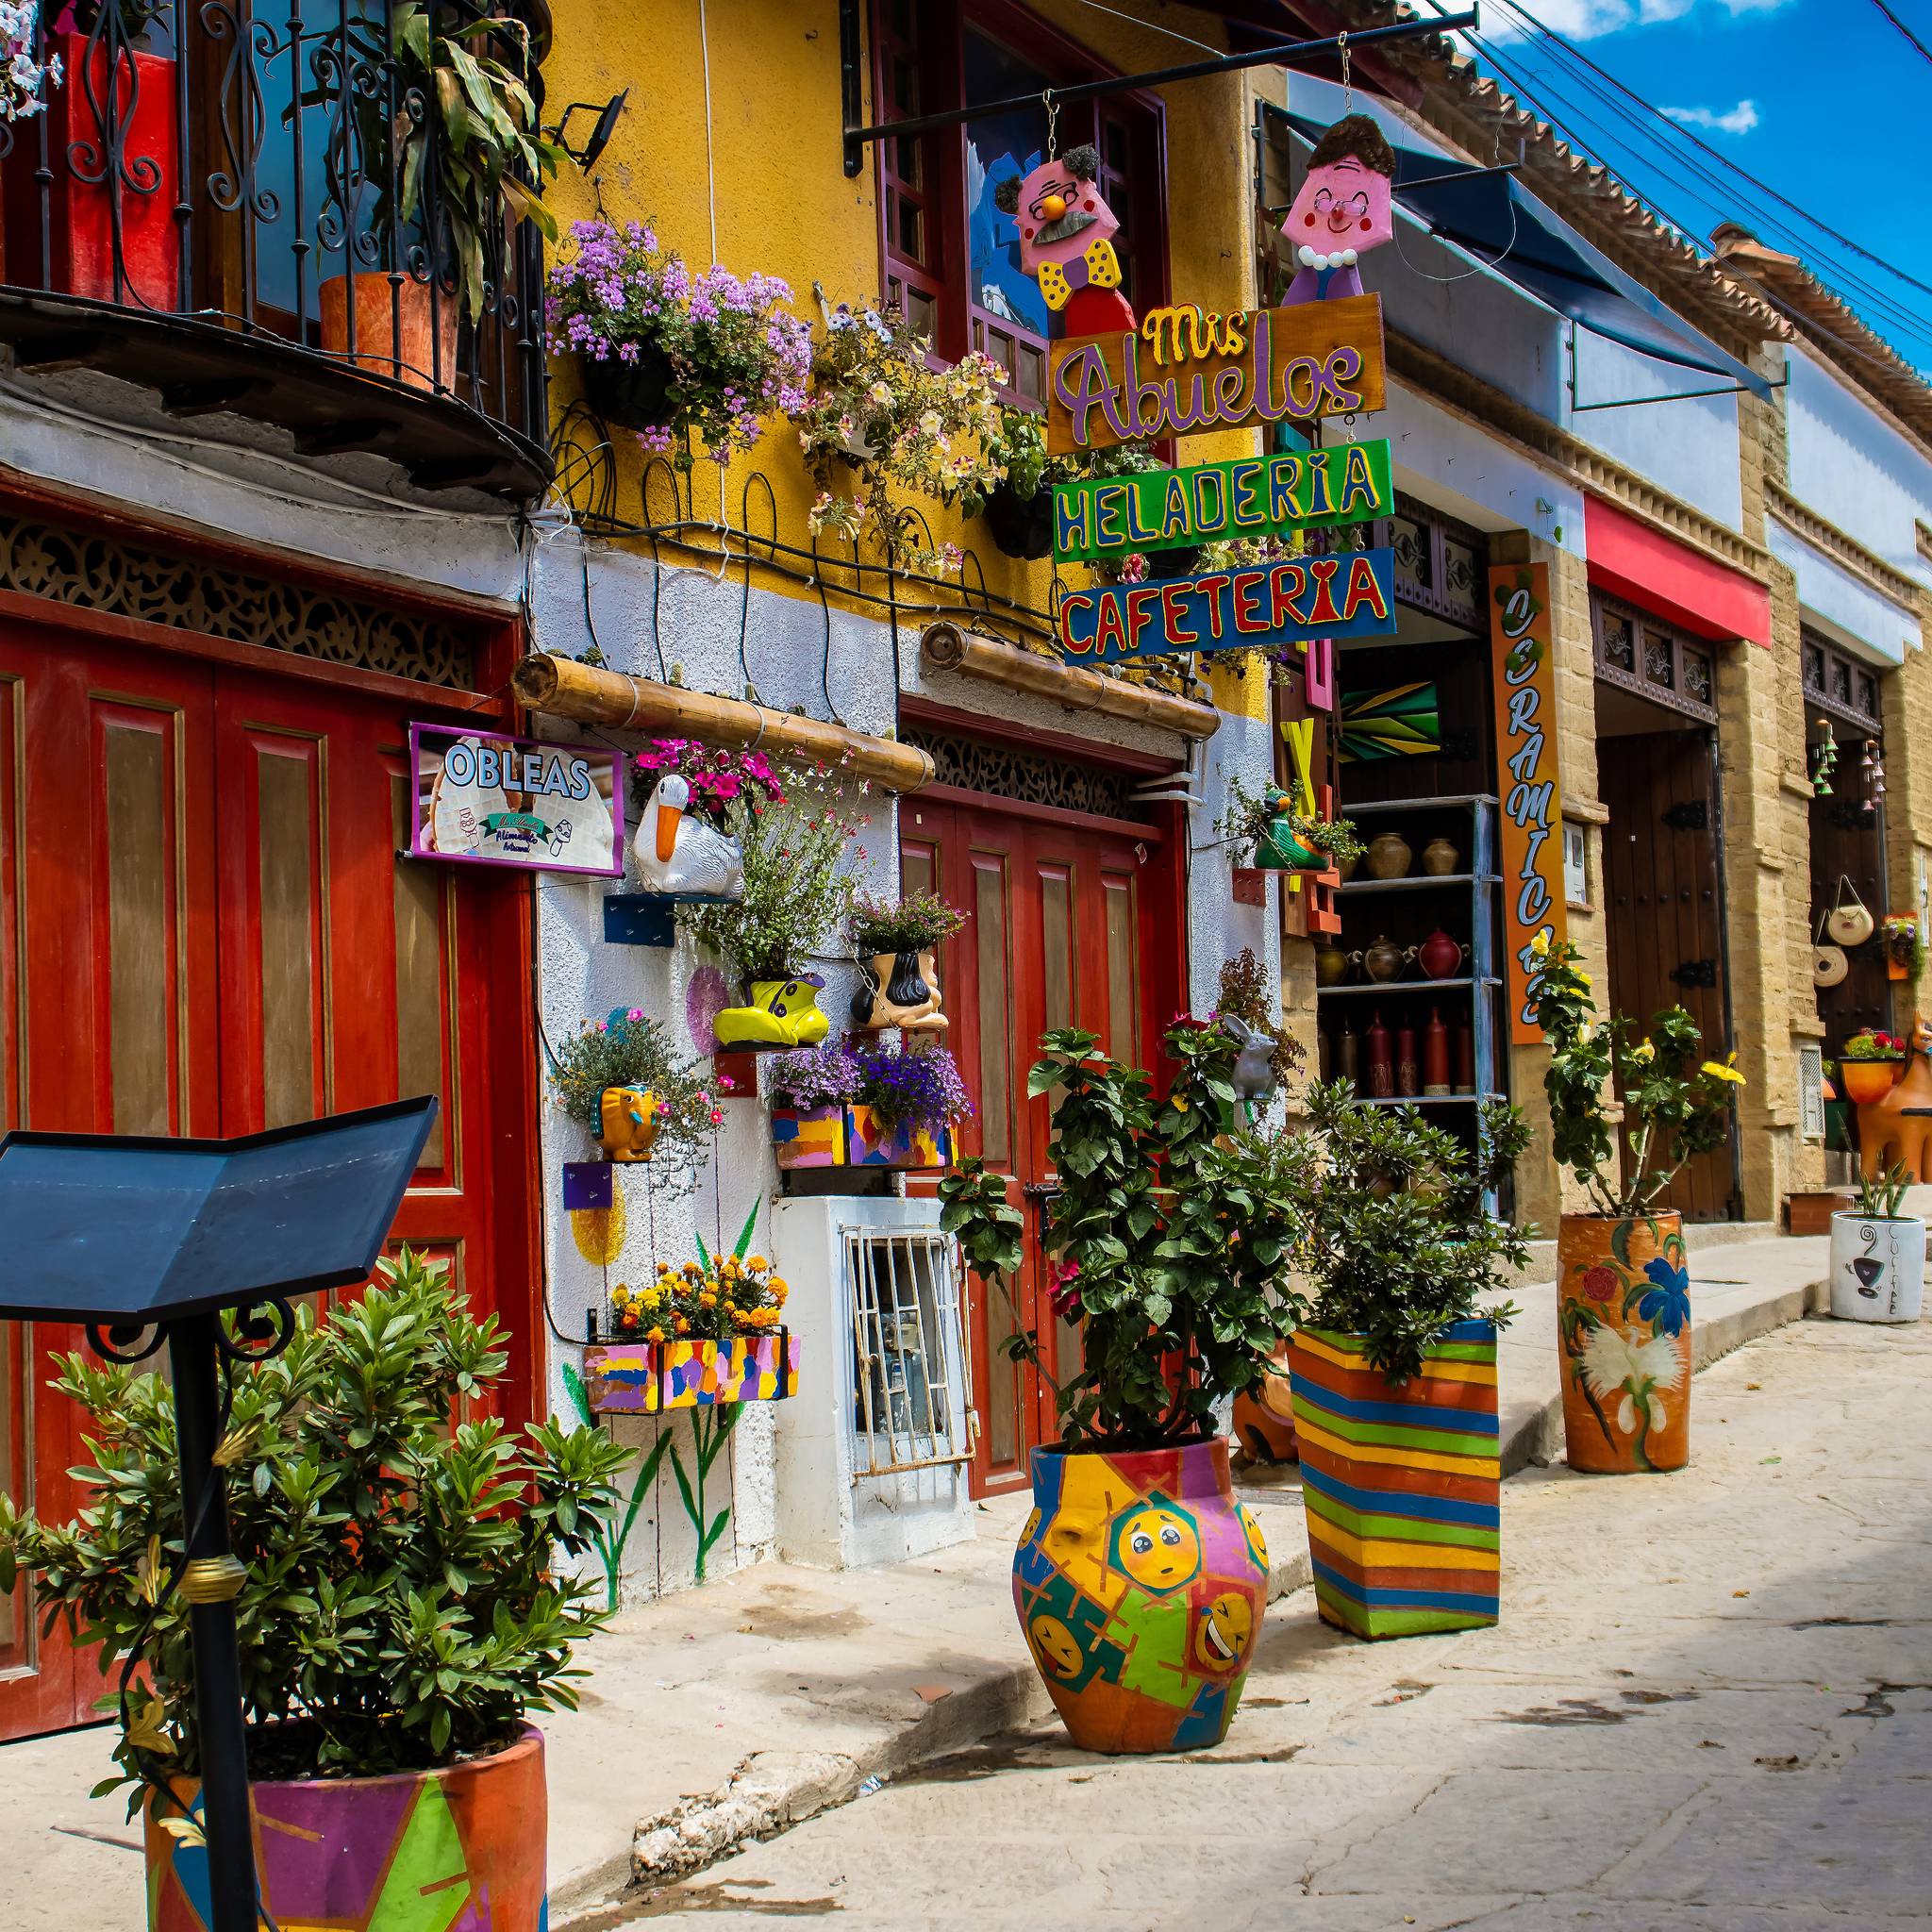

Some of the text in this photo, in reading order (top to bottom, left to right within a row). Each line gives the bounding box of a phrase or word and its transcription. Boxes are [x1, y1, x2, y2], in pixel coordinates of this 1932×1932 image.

[1142, 303, 1249, 366] Mis
[1054, 310, 1365, 446] Abuelos
[1057, 447, 1381, 553] HELADERIA
[1060, 558, 1389, 655] CAFETERIA
[444, 742, 591, 801] OBLEAS
[496, 830, 539, 845] Alimento
